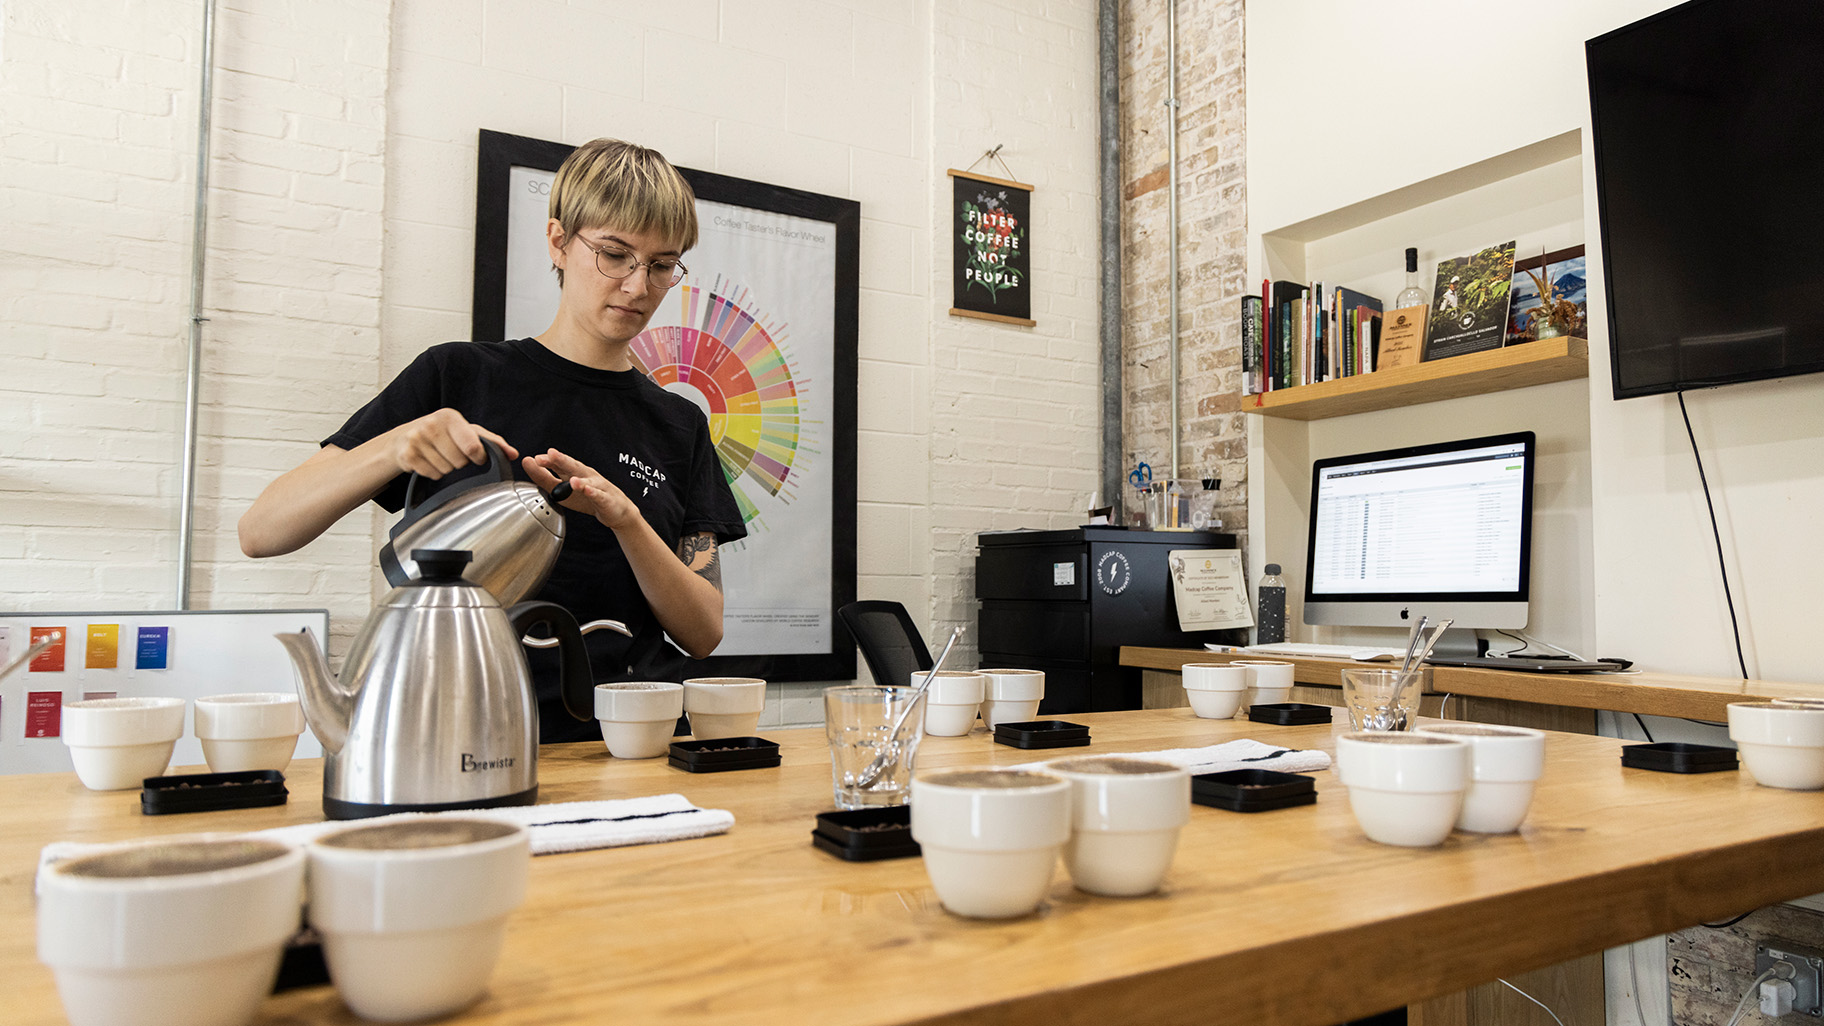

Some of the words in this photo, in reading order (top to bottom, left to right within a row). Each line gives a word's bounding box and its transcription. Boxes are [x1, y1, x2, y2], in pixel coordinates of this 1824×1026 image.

[714, 216, 742, 230] Coffee
[744, 221, 774, 235] Taster's
[776, 227, 800, 239] Flavor
[801, 231, 826, 243] Wheel
[969, 210, 1016, 230] FILTER
[965, 229, 1018, 249] COFFEE
[977, 250, 1008, 266] NOT
[966, 268, 1019, 287] PEOPLE
[618, 452, 666, 482] MADCAP
[630, 470, 659, 488] COFFEE
[1098, 551, 1115, 567] MADCAP
[1116, 552, 1130, 570] COFFEE
[1115, 572, 1130, 594] COMPANY
[461, 753, 516, 772] Brewista
